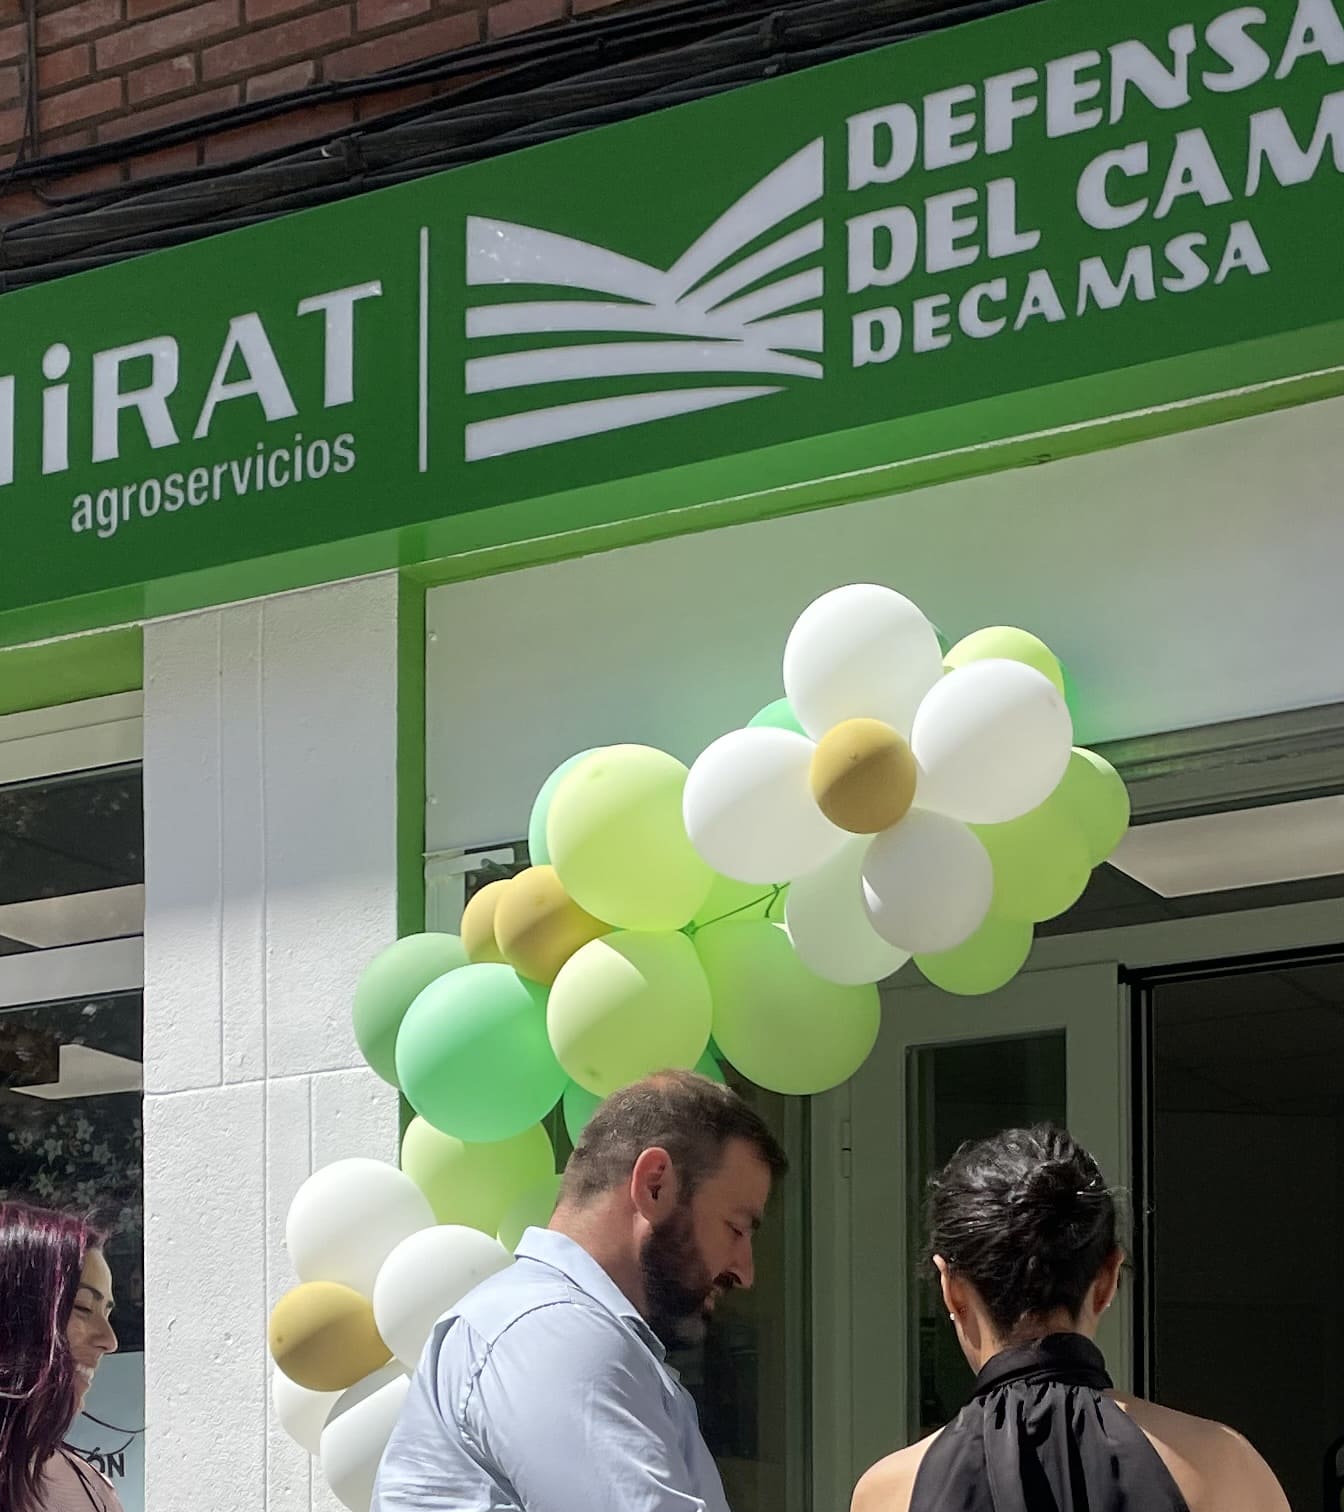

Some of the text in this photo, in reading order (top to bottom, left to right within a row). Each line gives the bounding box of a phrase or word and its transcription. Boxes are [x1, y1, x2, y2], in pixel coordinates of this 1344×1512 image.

[845, 176, 1042, 293] DEL
[852, 220, 1271, 367] DECAMSA
[71, 432, 356, 538] agroservicios
